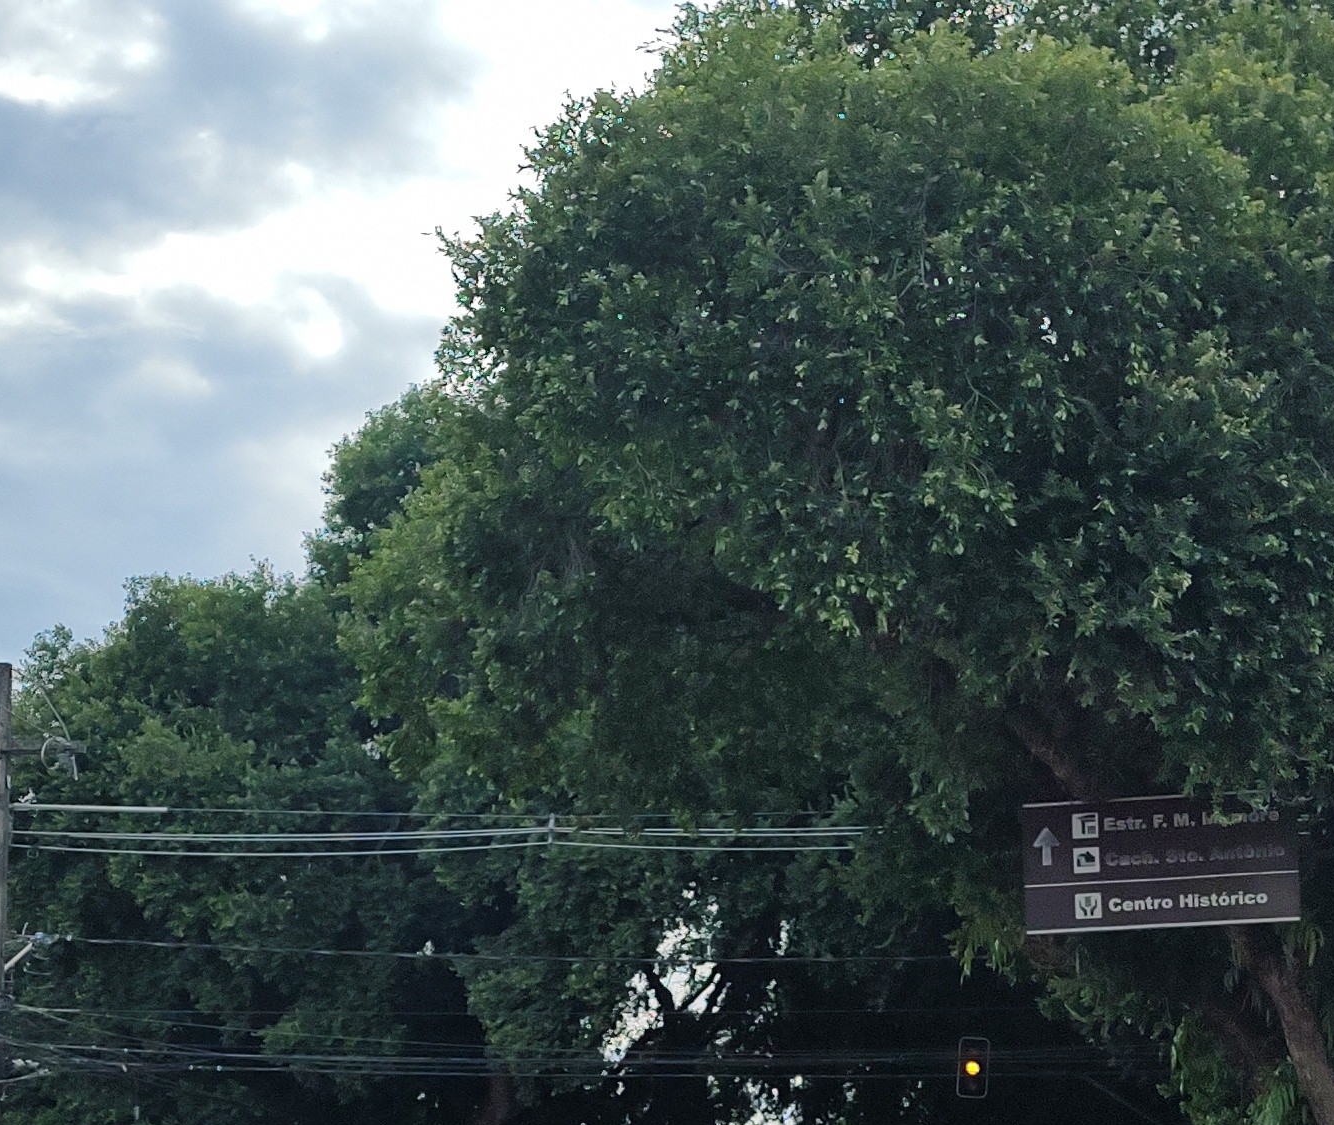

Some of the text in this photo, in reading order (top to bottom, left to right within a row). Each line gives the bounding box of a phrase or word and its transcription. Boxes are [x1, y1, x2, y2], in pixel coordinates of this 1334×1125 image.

[1104, 816, 1147, 832] Estr.
[1153, 813, 1168, 829] F.
[1173, 812, 1196, 828] M.
[1165, 848, 1204, 864] Sto.
[1108, 890, 1268, 912] Centro Histórico
